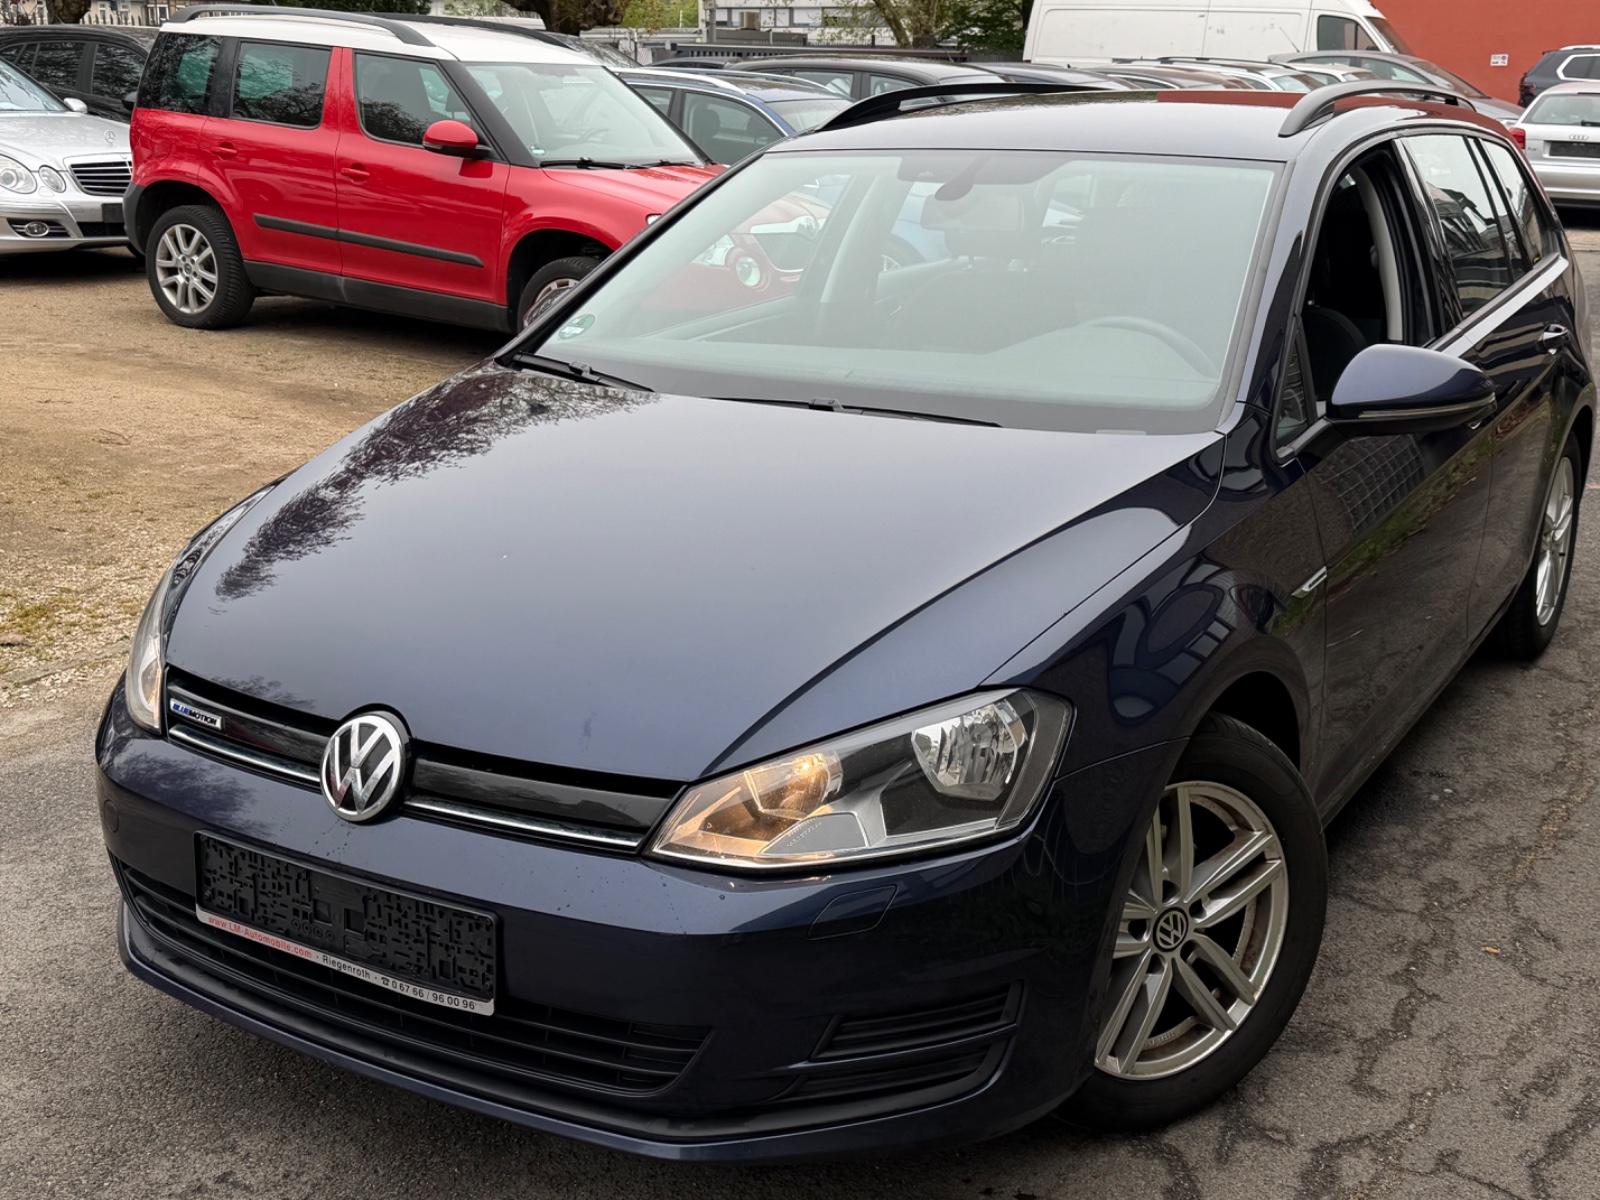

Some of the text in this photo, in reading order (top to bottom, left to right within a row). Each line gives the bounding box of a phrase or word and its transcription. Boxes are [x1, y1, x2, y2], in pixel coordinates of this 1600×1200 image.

[321, 714, 405, 820] VW
[322, 954, 371, 979] Riegenroth
[399, 983, 410, 992] 67
[412, 987, 424, 998] 66
[431, 993, 445, 1003] 96
[446, 996, 460, 1007] 00
[461, 1000, 475, 1010] 96
